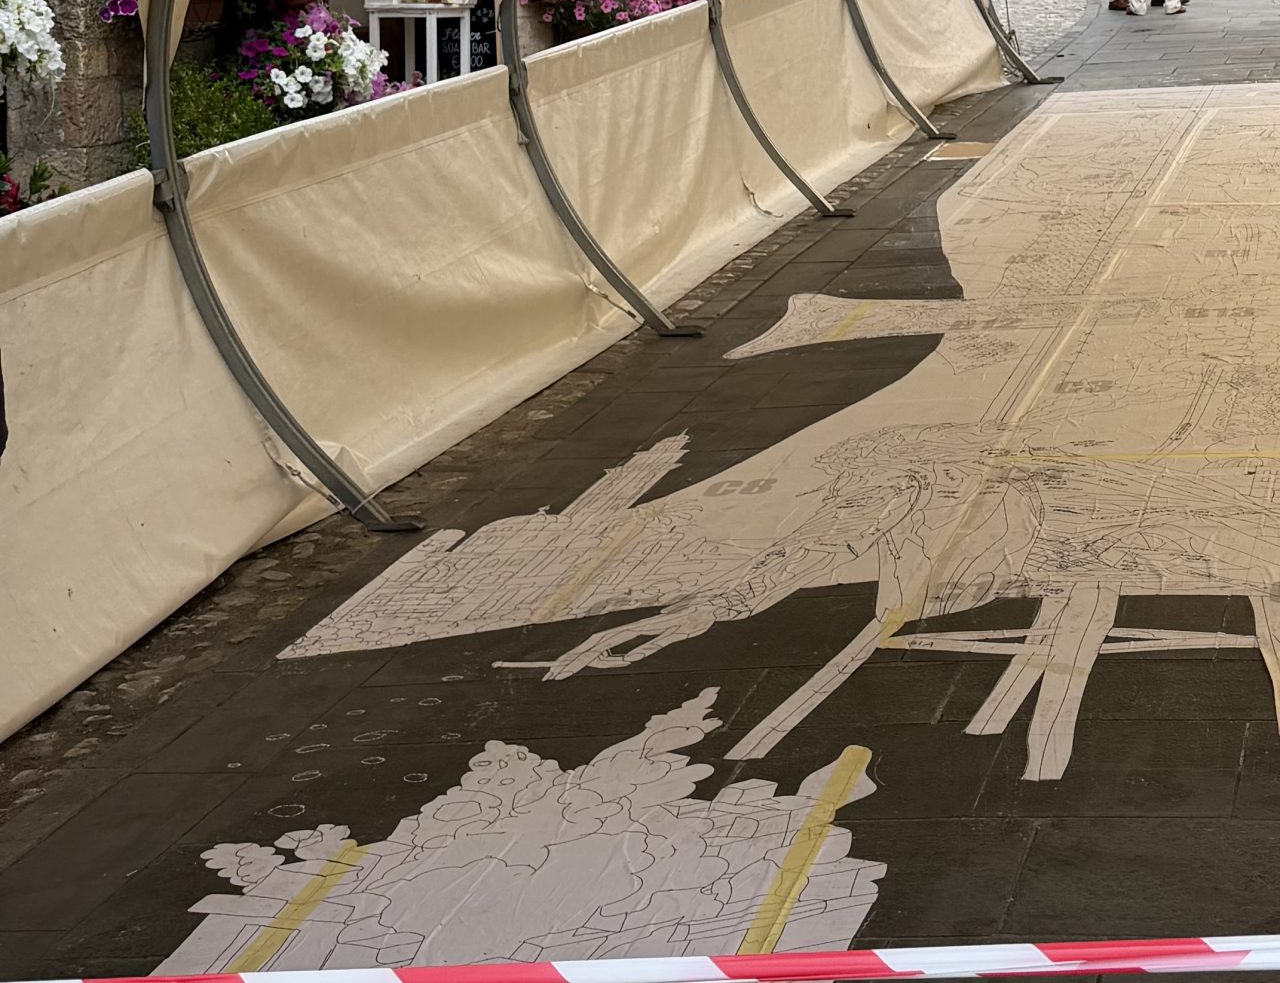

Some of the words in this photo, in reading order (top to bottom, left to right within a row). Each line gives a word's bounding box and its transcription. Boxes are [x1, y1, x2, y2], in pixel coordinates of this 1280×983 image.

[472, 42, 490, 54] BAR
[1053, 378, 1114, 394] C3
[703, 477, 778, 497] C8
